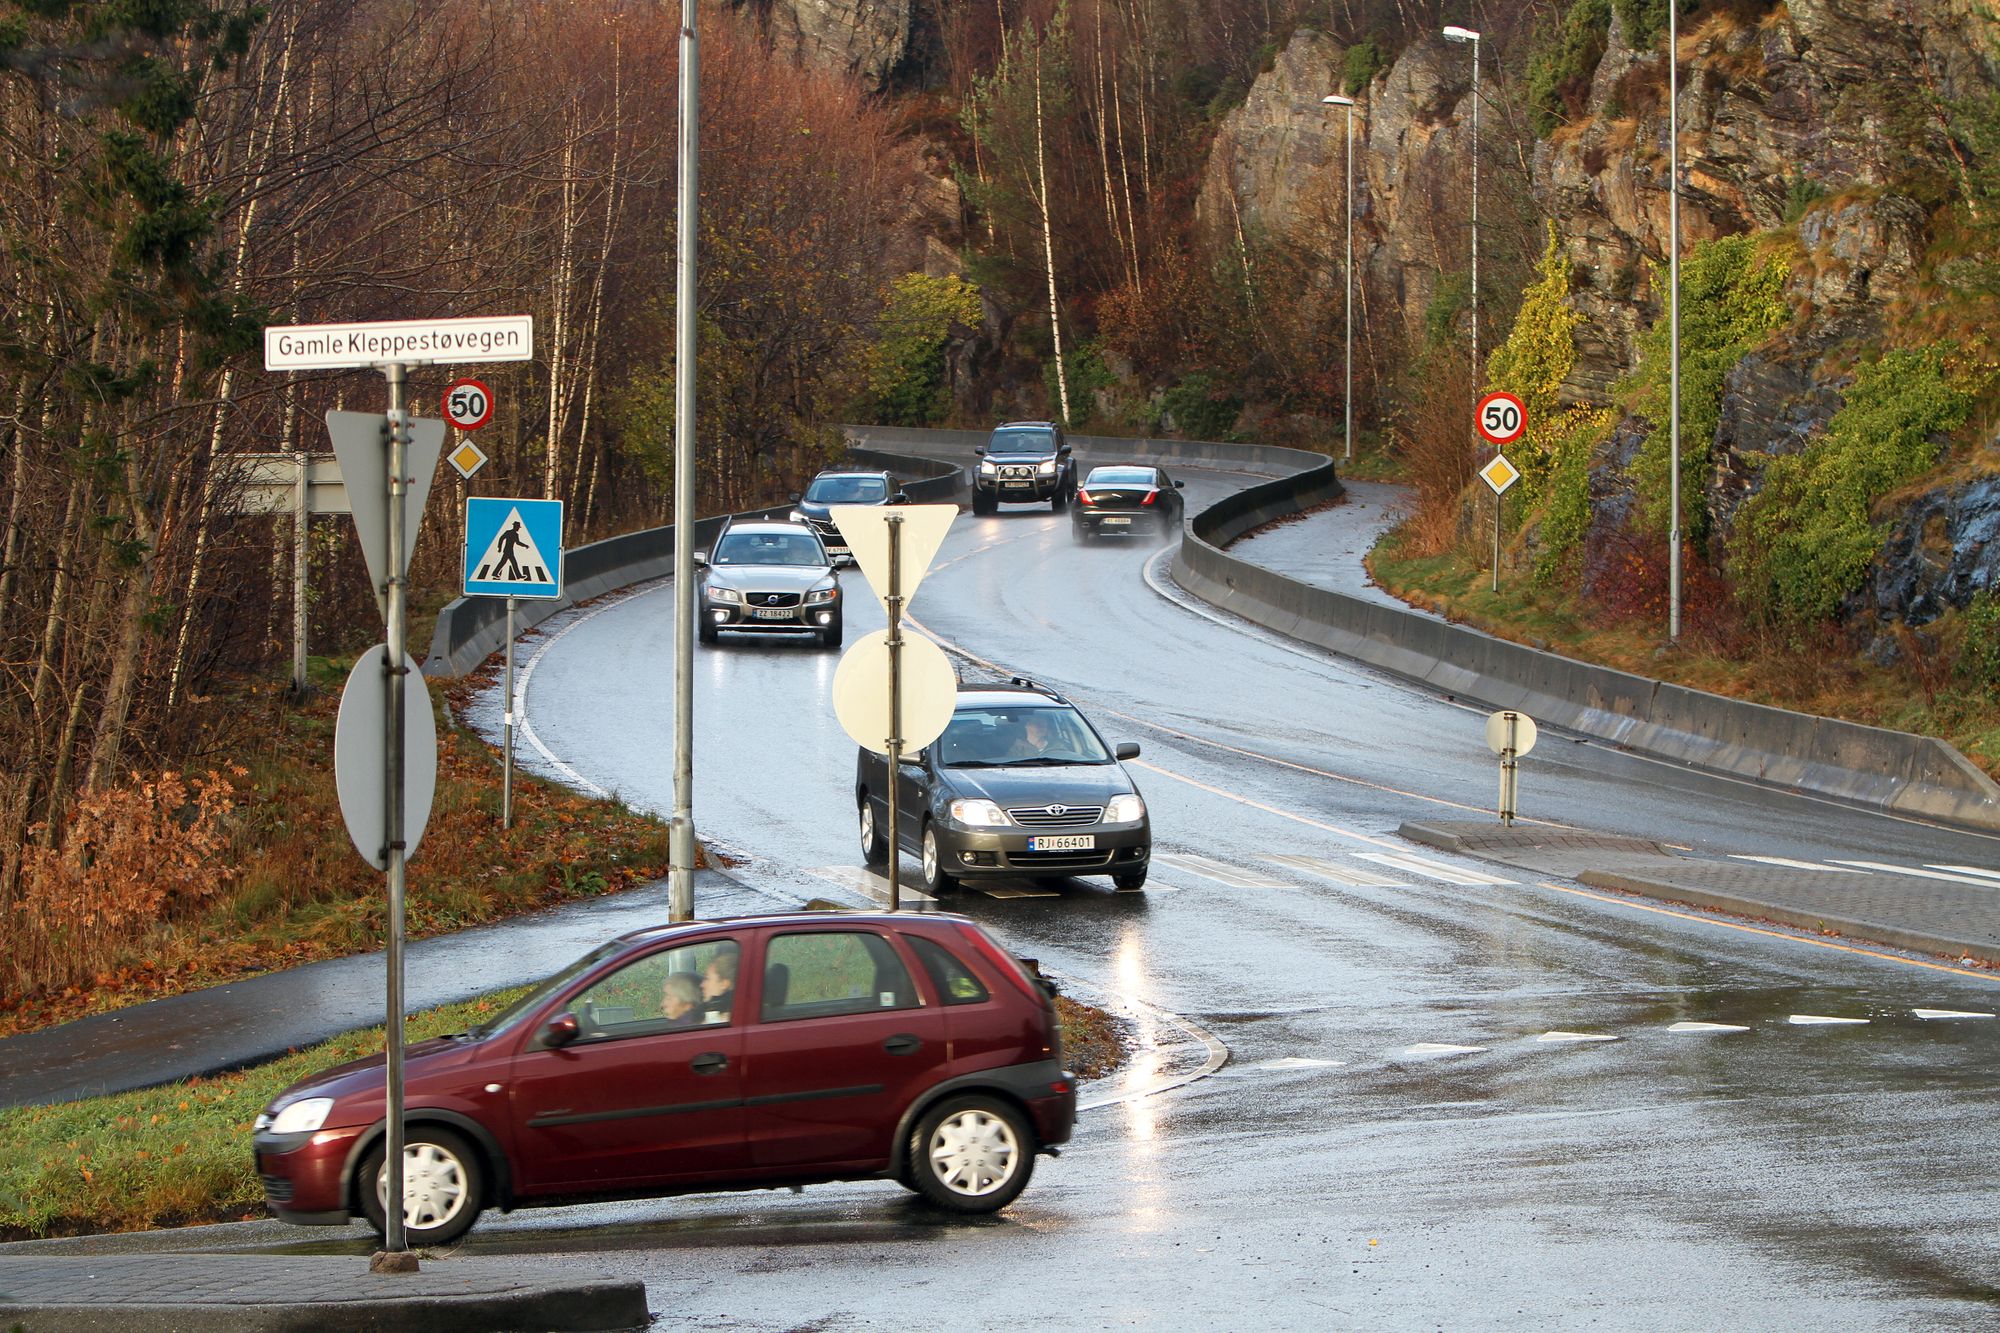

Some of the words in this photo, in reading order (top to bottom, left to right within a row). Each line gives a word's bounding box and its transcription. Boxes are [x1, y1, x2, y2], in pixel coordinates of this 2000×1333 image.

[279, 334, 343, 356] Gamle
[348, 330, 519, 357] Kleppestøvegen
[451, 393, 485, 418] 50
[1485, 406, 1519, 431] 50
[1038, 838, 1051, 849] RJ
[1056, 837, 1091, 848] 66401
